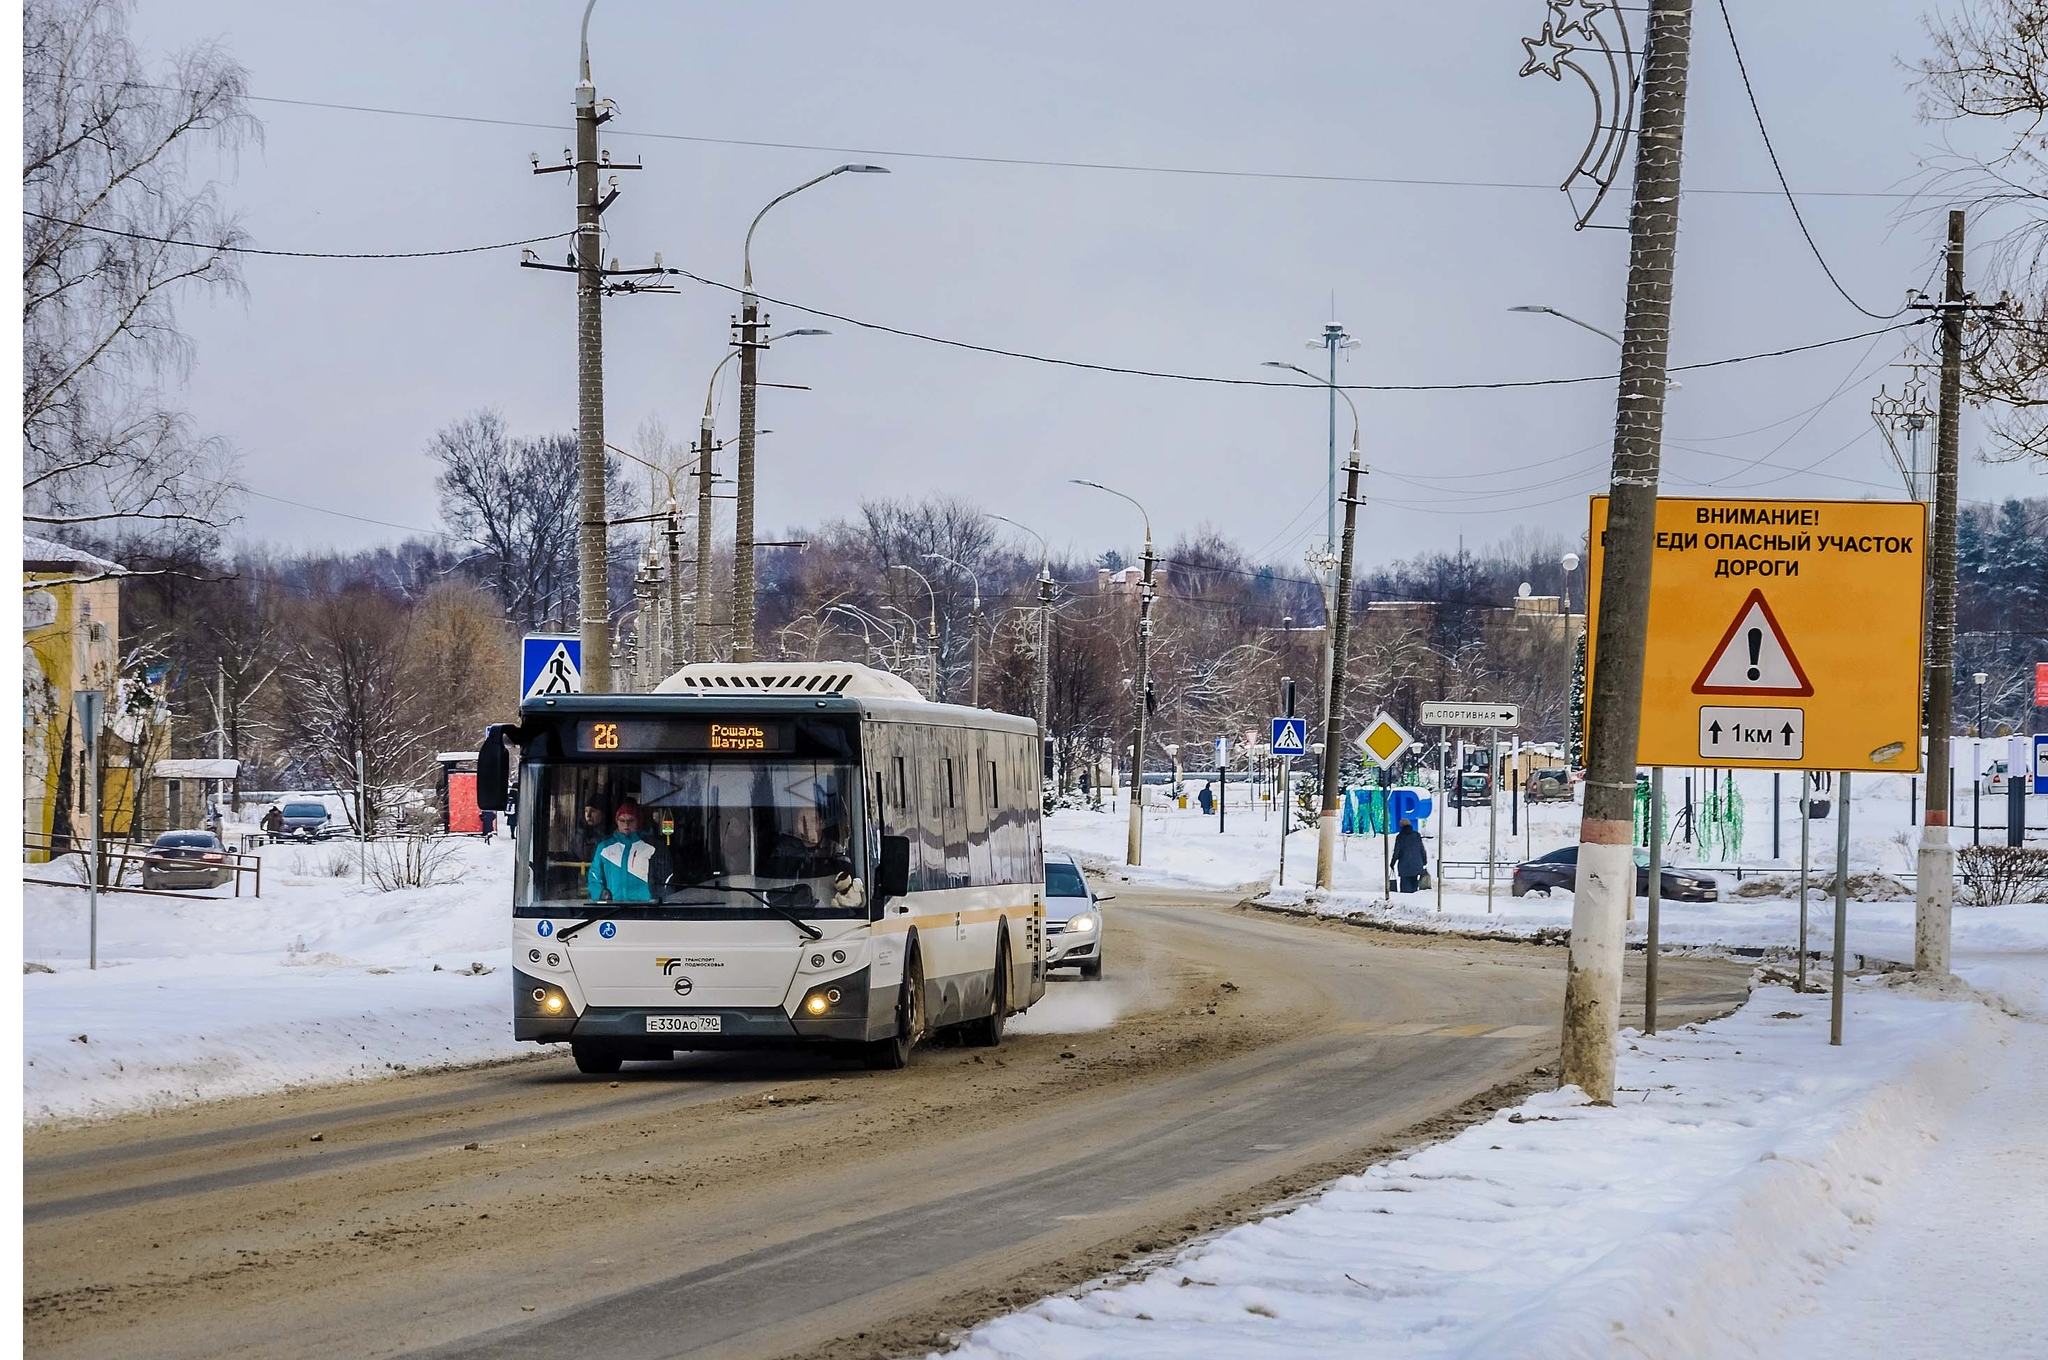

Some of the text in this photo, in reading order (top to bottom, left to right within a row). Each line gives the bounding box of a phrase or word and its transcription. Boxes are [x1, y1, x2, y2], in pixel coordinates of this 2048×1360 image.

[1697, 508, 1819, 526] ВНИМАНИЕ!
[1704, 531, 1811, 551] ОПАСНЫЙ
[1818, 536, 1913, 553] УЧАСТОК
[1715, 559, 1799, 578] ДОРОГИ
[594, 723, 619, 749] 26
[711, 724, 764, 737] Рошаль
[711, 737, 764, 749] Шатура
